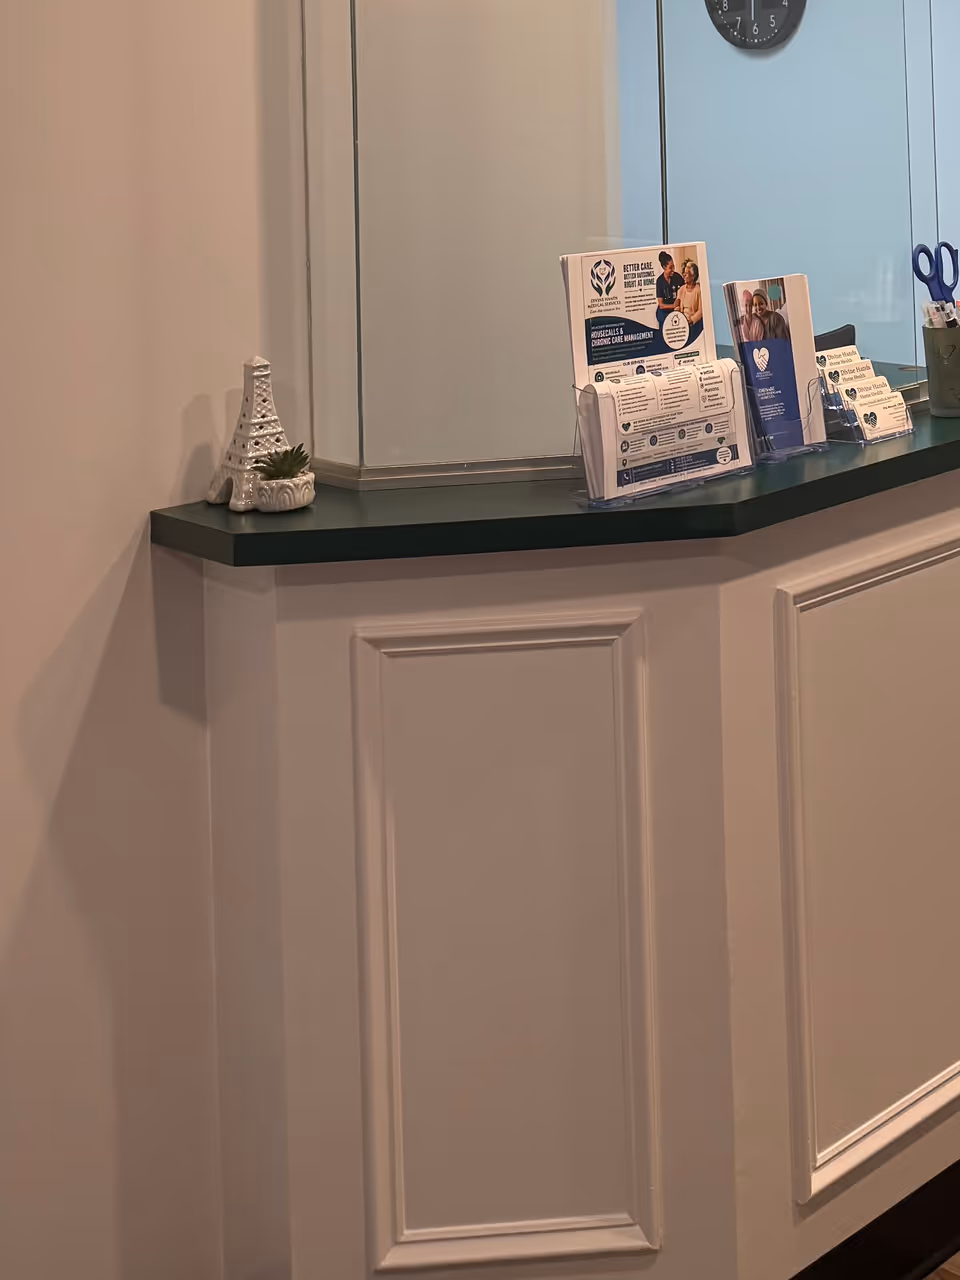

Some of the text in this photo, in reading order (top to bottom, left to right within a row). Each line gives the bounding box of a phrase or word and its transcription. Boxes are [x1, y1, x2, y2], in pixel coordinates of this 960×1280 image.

[723, 0, 728, 11] 8
[736, 17, 741, 29] 7
[770, 15, 776, 27] 5
[753, 23, 759, 34] 6
[623, 263, 640, 272] BETTER
[591, 328, 619, 338] HOUSECALLS
[611, 335, 623, 344] CARE
[624, 331, 653, 342] MANAGEMENT
[856, 364, 871, 372] Hands
[872, 381, 887, 389] Hands
